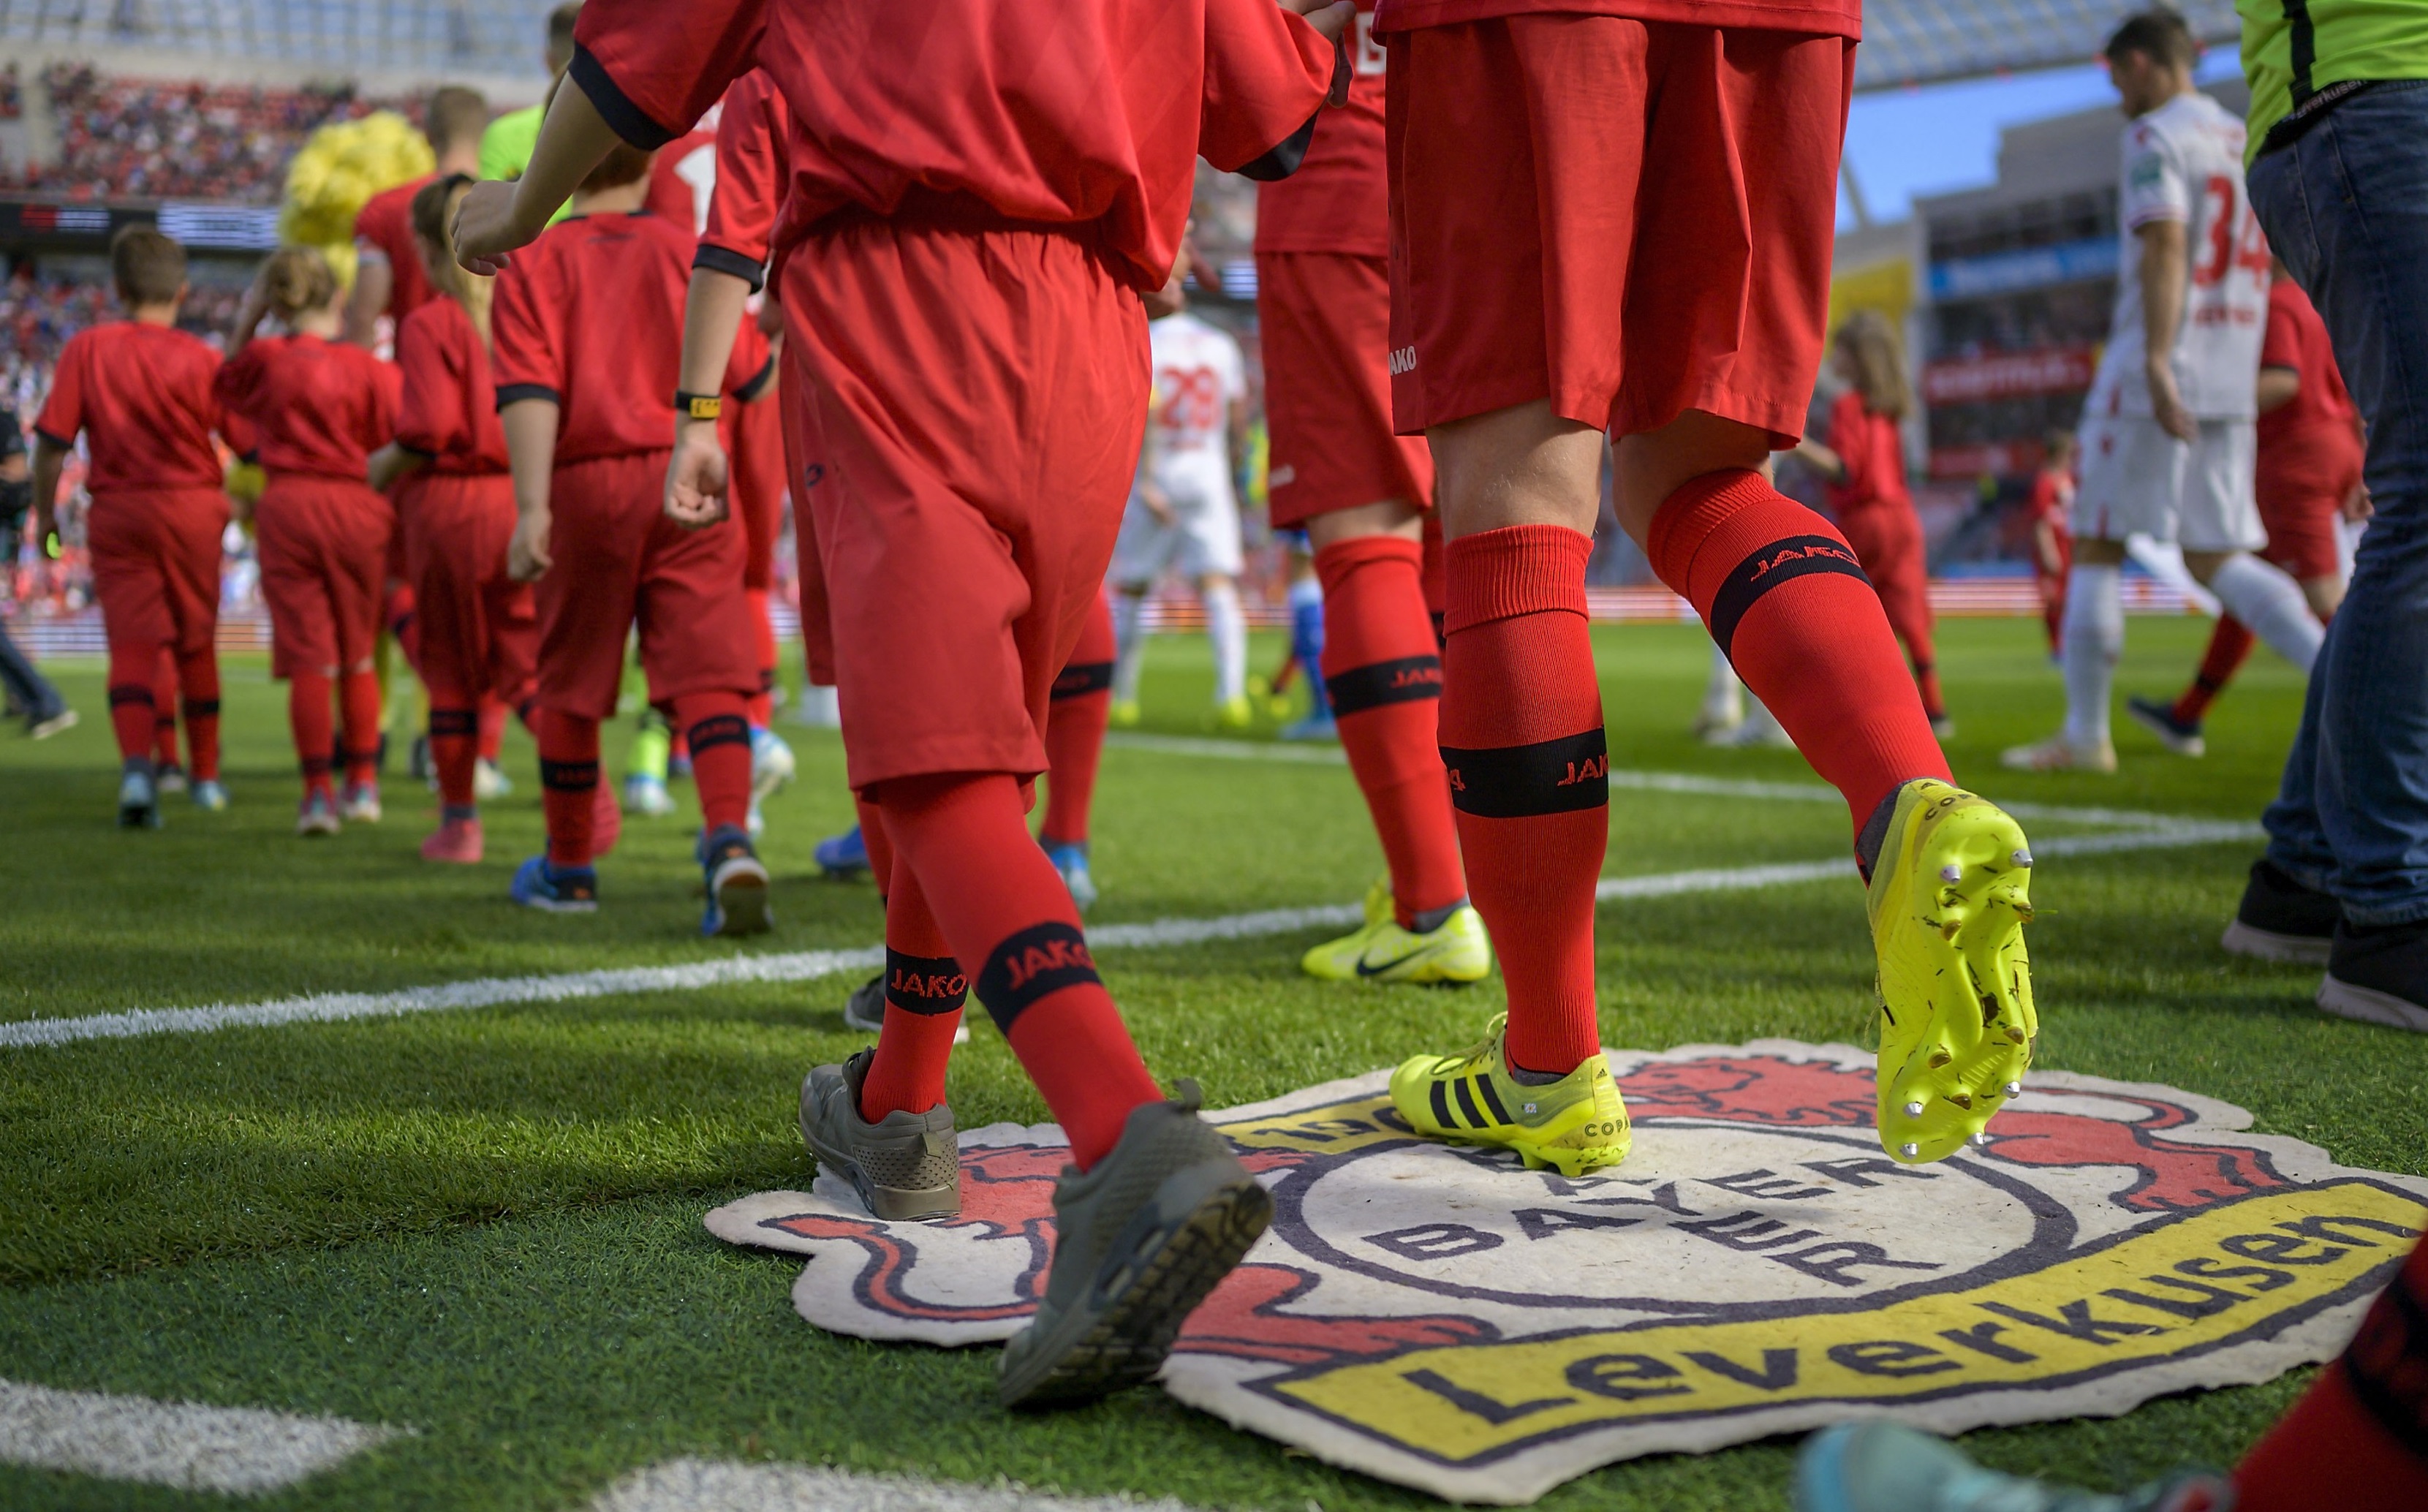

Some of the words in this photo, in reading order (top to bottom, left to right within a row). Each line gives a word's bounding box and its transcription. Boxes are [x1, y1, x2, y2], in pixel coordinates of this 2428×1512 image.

[2193, 175, 2271, 290] 34
[1389, 345, 1417, 376] AKO
[1557, 752, 1609, 787] JAK
[890, 968, 968, 999] JAKO
[1362, 1157, 1942, 1261] BAYER
[1401, 1216, 2426, 1425] Leverkusen
